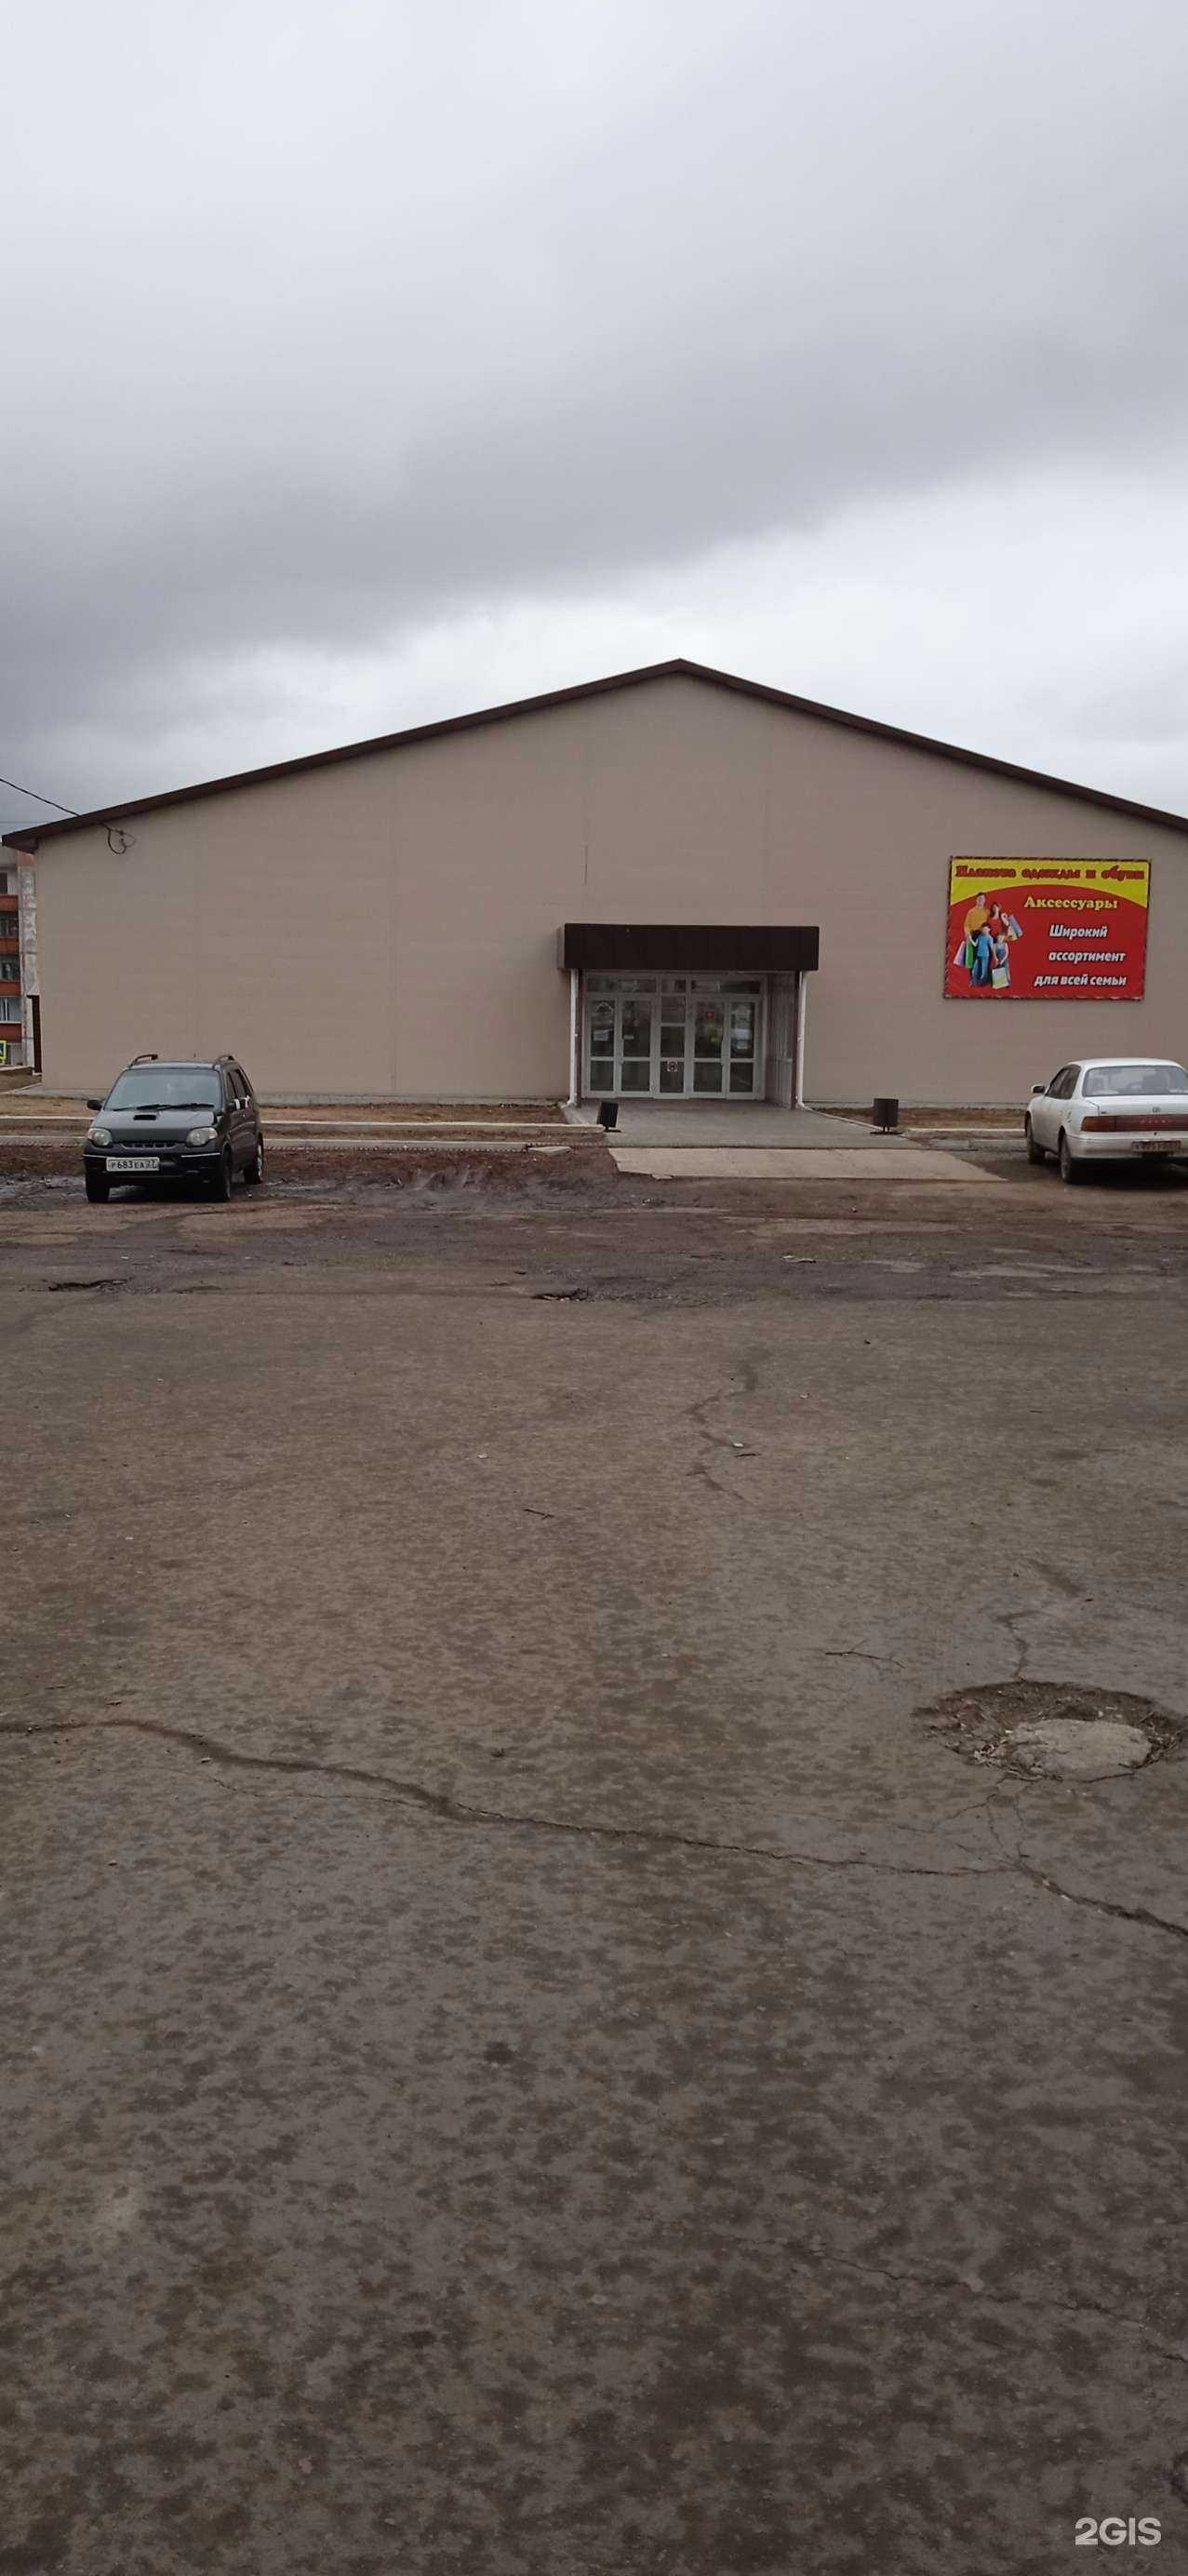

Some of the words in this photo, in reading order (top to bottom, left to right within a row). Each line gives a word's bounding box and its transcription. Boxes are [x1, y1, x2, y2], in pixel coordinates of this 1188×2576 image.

[1021, 867, 1081, 879] одежды
[1085, 869, 1096, 879] и
[1101, 865, 1145, 881] обуви
[1023, 896, 1118, 909] Аксессуары
[1048, 924, 1109, 940] Широкий
[1048, 951, 1127, 964] ассортимент
[1034, 975, 1060, 986] для
[1060, 974, 1089, 986] всей
[1089, 976, 1127, 986] семьи
